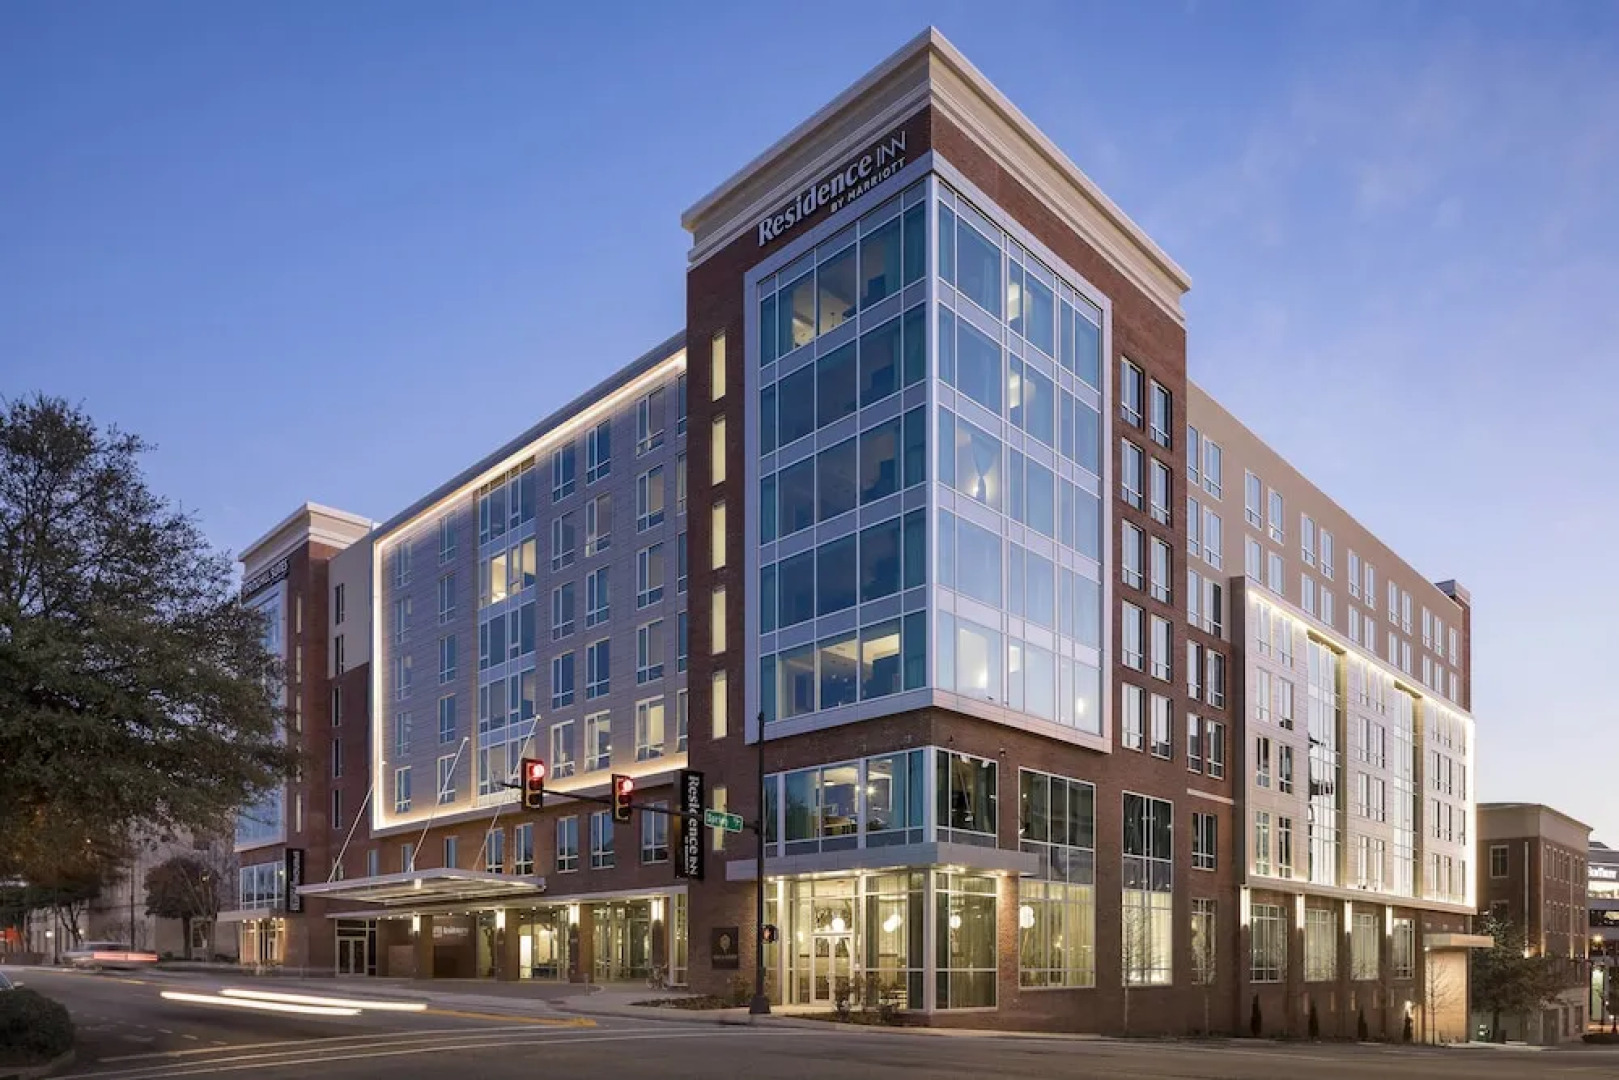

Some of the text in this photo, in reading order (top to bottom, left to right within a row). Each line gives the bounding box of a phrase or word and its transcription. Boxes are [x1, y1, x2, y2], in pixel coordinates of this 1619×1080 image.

[758, 131, 905, 246] Residence INN
[831, 157, 905, 212] BY MARRIOTT
